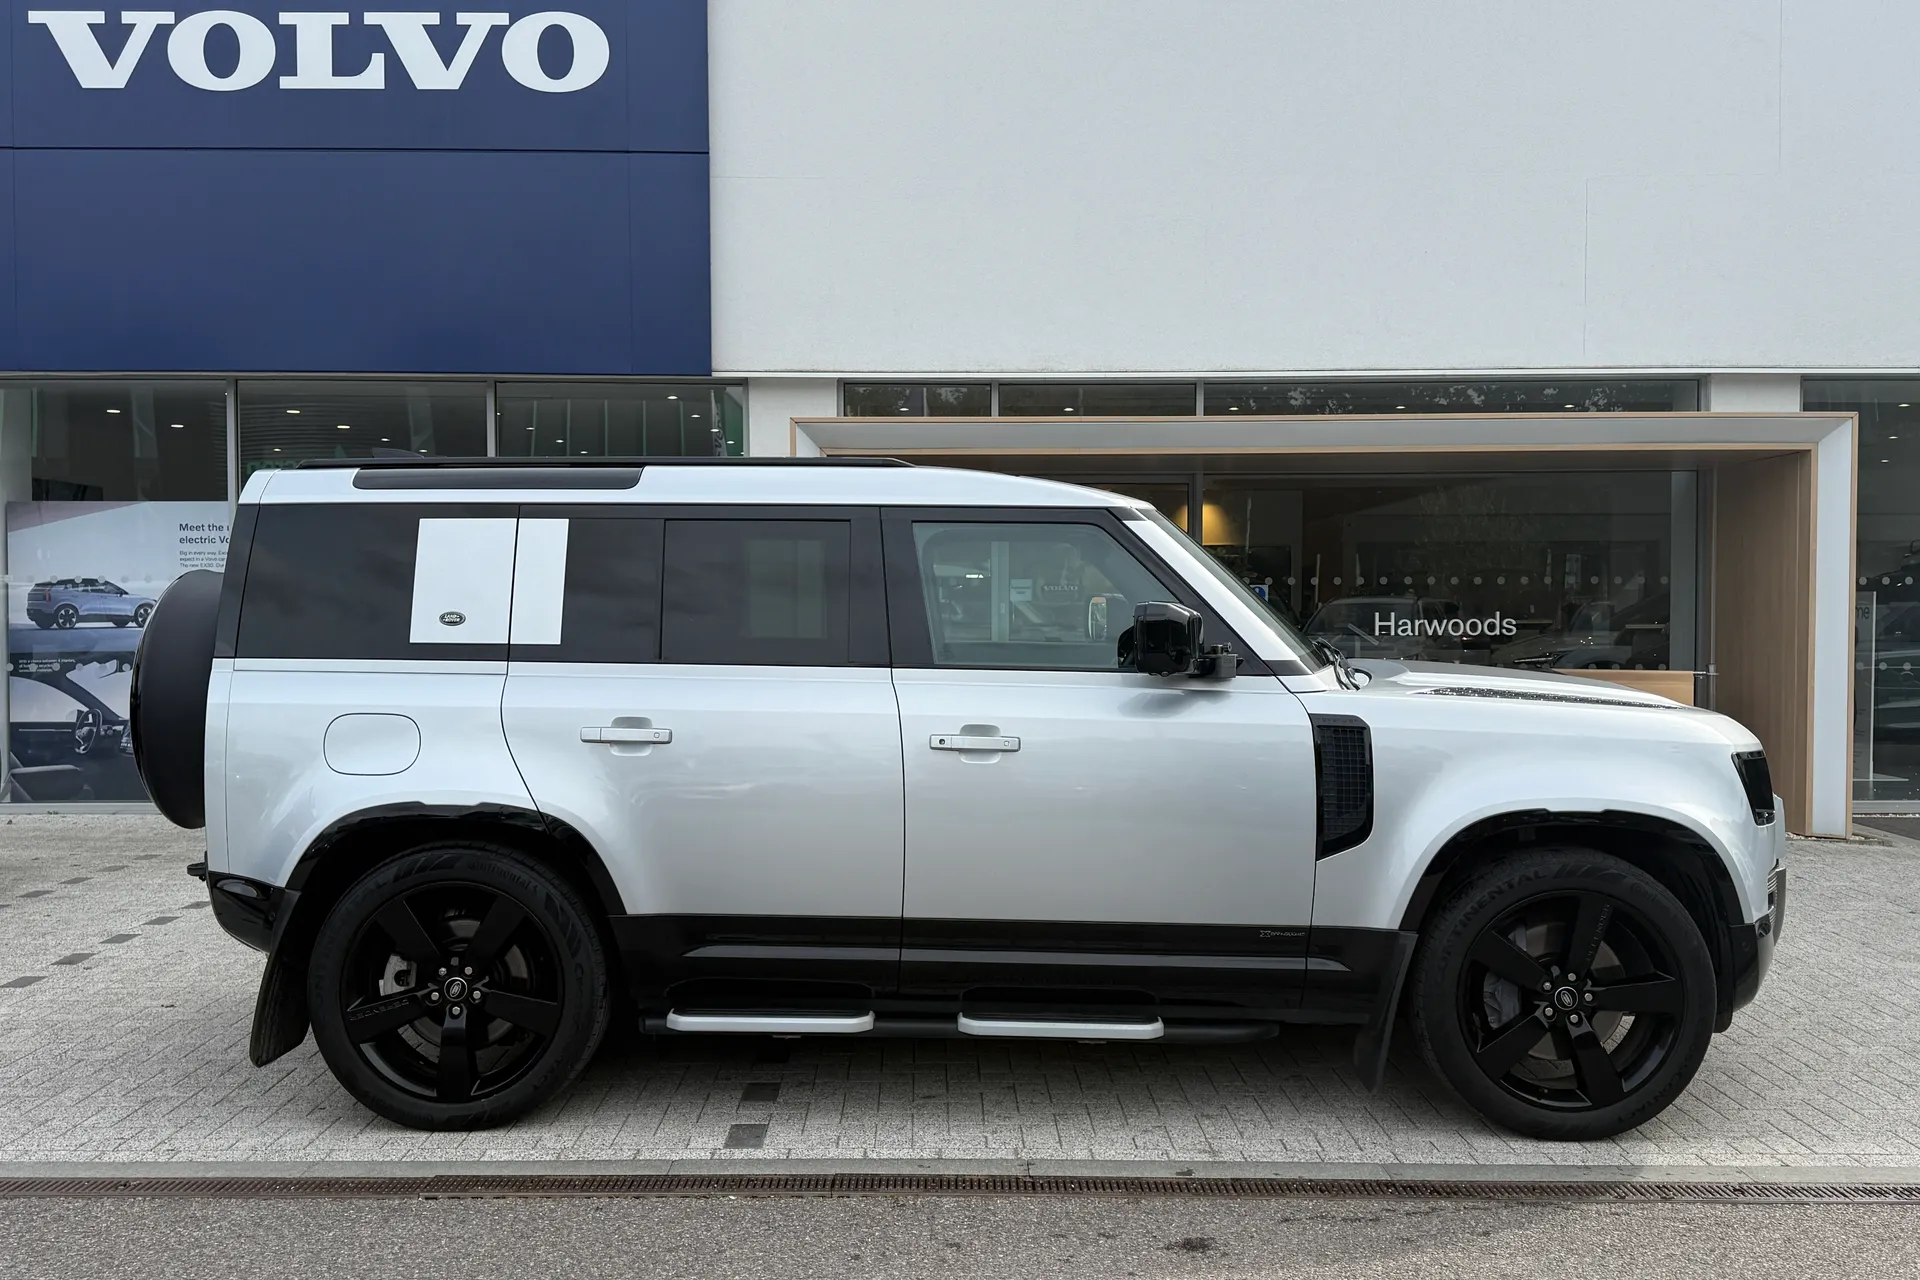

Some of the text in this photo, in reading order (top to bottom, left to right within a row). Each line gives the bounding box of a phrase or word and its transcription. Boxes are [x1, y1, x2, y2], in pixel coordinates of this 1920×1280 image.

[28, 10, 610, 93] VOLVO
[179, 523, 205, 531] Meet
[207, 523, 224, 531] the
[179, 535, 216, 544] electric
[1374, 611, 1517, 636] Harwoods
